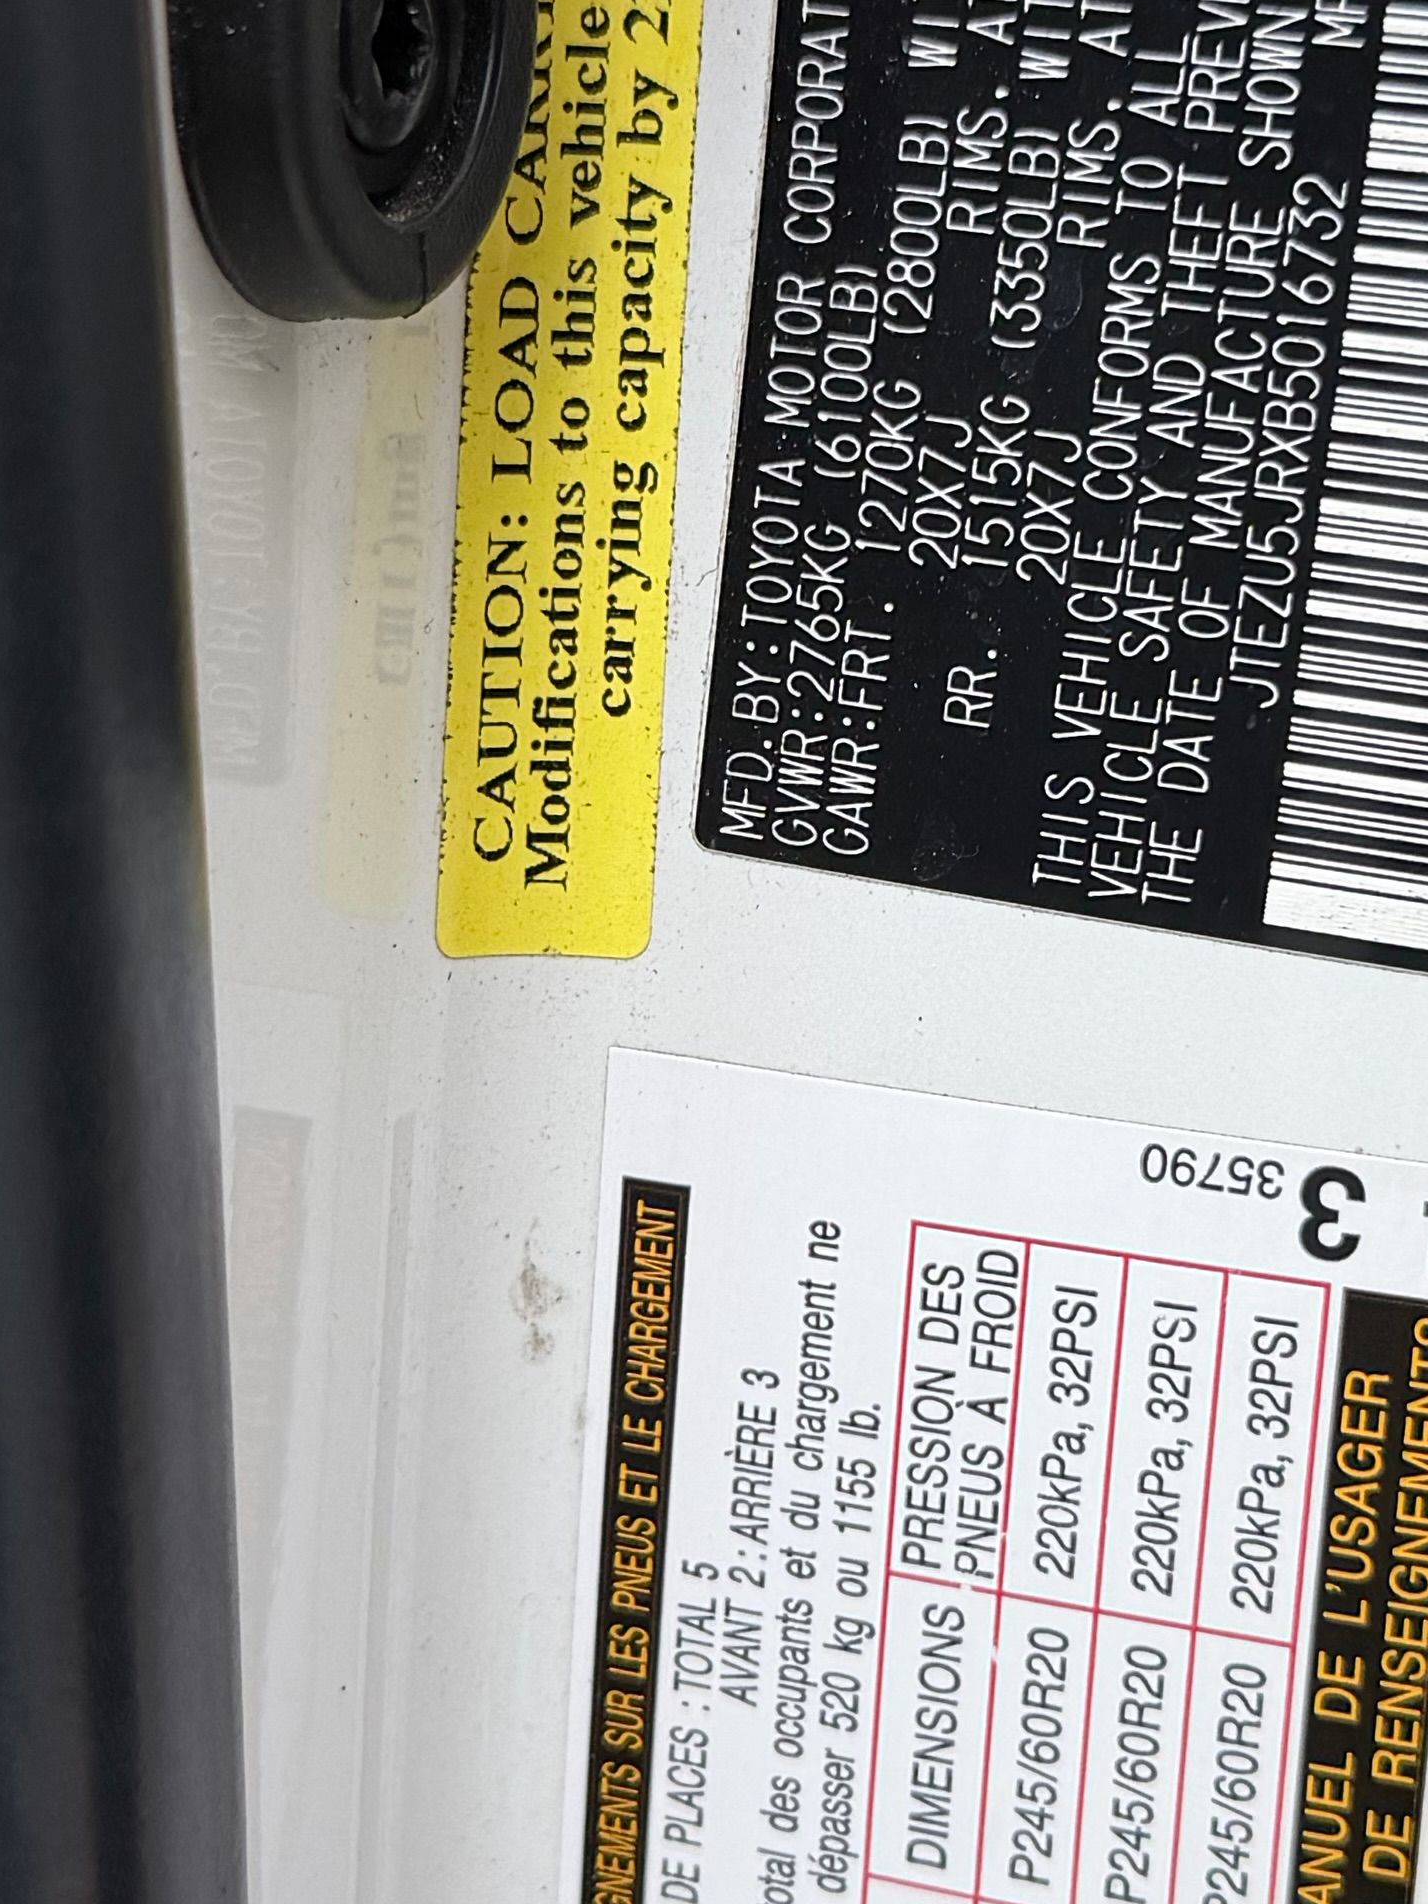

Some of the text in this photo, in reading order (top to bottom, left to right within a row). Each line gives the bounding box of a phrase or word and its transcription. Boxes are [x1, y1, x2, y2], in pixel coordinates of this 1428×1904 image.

[556, 4, 614, 227] vehicle
[616, 68, 681, 147] by
[1127, 30, 1189, 126] ALL
[1237, 2, 1308, 171] SHOWN
[880, 114, 950, 334] (2800LB)
[1115, 155, 1173, 218] TO
[1160, 162, 1230, 321] THEFT
[549, 255, 599, 366] this
[600, 165, 676, 431] capacity
[764, 272, 825, 427] MOTOR
[490, 275, 541, 483] LOAD
[548, 397, 591, 452] to
[812, 262, 879, 480] (6100LB)
[1082, 249, 1162, 503] CONFORMS
[1146, 352, 1207, 447] AND
[1189, 199, 1284, 548] MANUFACTURE
[855, 378, 922, 554] 1270KG
[1226, 172, 1348, 709] JTEZU5JRXB5016732
[584, 459, 659, 718] carrying
[1118, 476, 1191, 661] SAFETY
[1178, 576, 1234, 639] OF
[472, 512, 531, 862] CAUTION:
[522, 479, 590, 889] Modifications
[1051, 530, 1127, 743] VEHICLE
[1157, 668, 1222, 792] DATE
[1032, 772, 1094, 888] THIS
[1088, 690, 1162, 902] VEHICLE
[1141, 820, 1202, 908] THE
[1139, 1138, 1287, 1201] 35790
[1291, 1159, 1367, 1265] 3
[805, 1217, 841, 1262] ne
[624, 1199, 677, 1402] CHARGEMENT
[621, 1413, 663, 1452] LE
[783, 1276, 846, 1474] chargement
[838, 1397, 882, 1440] lb.
[900, 1259, 966, 1568] PRESSION DES
[952, 1245, 1020, 1577] PNEUS À FROID
[618, 1461, 660, 1503] ET
[779, 1487, 822, 1532] du
[832, 1454, 877, 1537] 1155
[611, 1511, 657, 1611] PNEUS
[777, 1545, 818, 1581] et
[834, 1555, 870, 1599] ou
[1008, 1623, 1073, 1886] P245/60R20
[1046, 1282, 1100, 1409] 32PSI
[607, 1621, 650, 1679] LES
[768, 1595, 823, 1760] occupants
[823, 1612, 875, 1656] kg
[1312, 1649, 1365, 1724] DE
[602, 1687, 646, 1749] SUR
[819, 1669, 862, 1734] 520
[904, 1599, 967, 1869] DIMENSIONS
[758, 1771, 802, 1833] des
[807, 1745, 866, 1896] dépasser
[1361, 1808, 1414, 1880] DE
